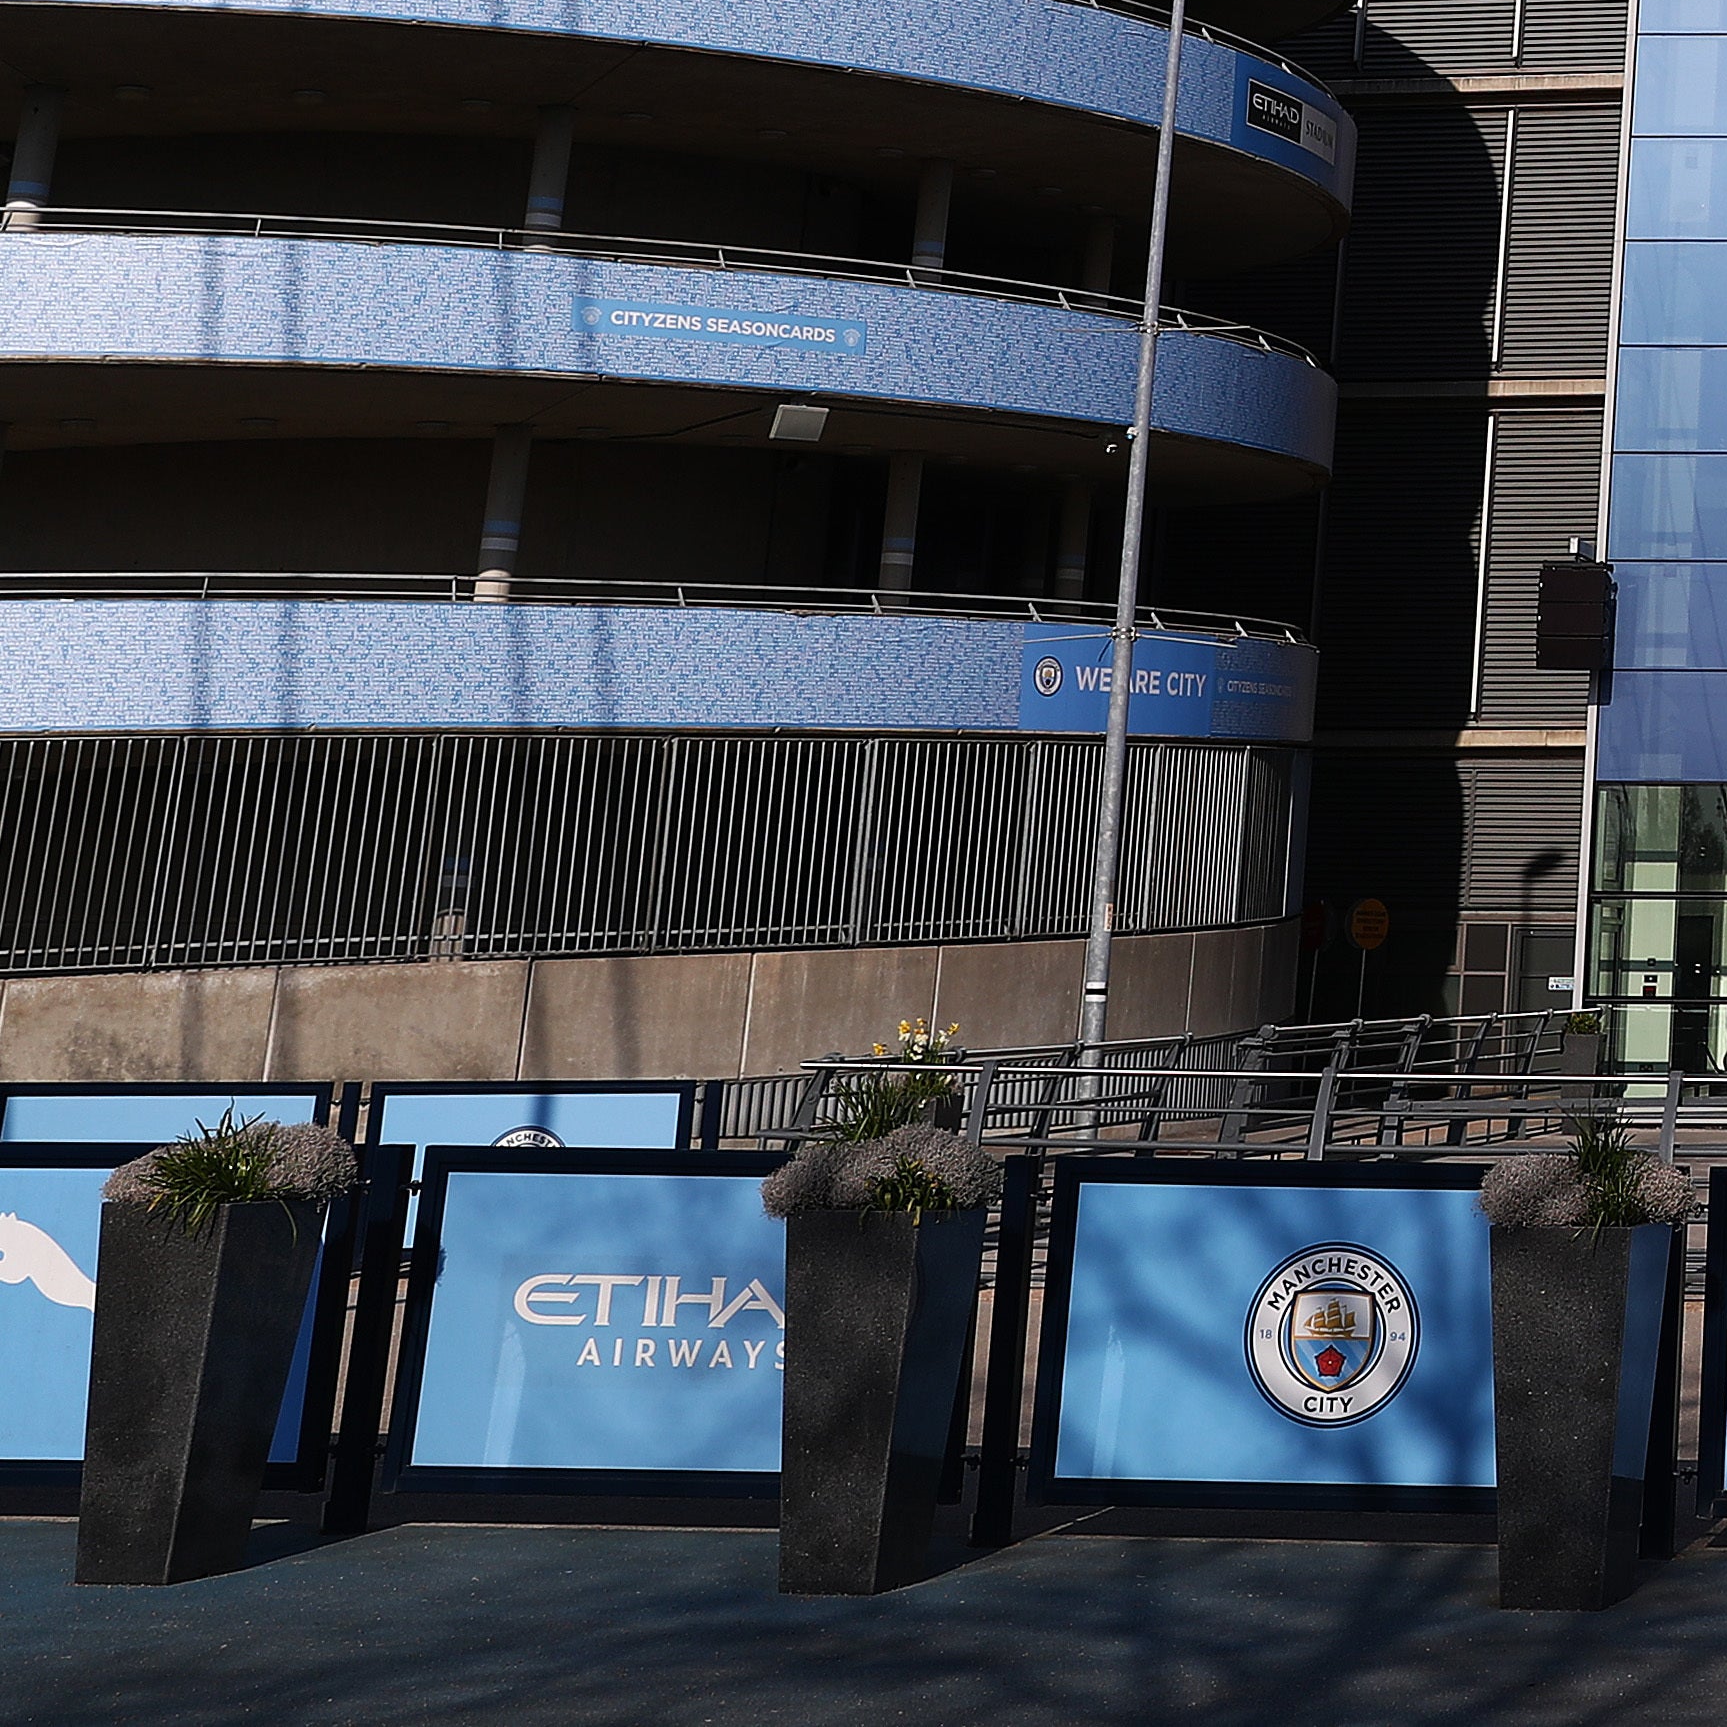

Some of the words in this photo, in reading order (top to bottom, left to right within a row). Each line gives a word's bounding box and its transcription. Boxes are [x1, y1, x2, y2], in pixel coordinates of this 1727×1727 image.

[1252, 93, 1300, 124] ETIHAD
[610, 310, 702, 331] CITYZENS
[706, 317, 836, 343] SEASONCARDS
[1075, 665, 1112, 693] WE
[1167, 672, 1207, 697] CITY
[500, 1133, 556, 1147] NCHEST
[1267, 1256, 1401, 1313] MANCHESTER
[513, 1273, 785, 1329] ETIHA
[1260, 1329, 1273, 1339] 18
[1389, 1331, 1406, 1342] 94
[1303, 1396, 1353, 1413] CITY
